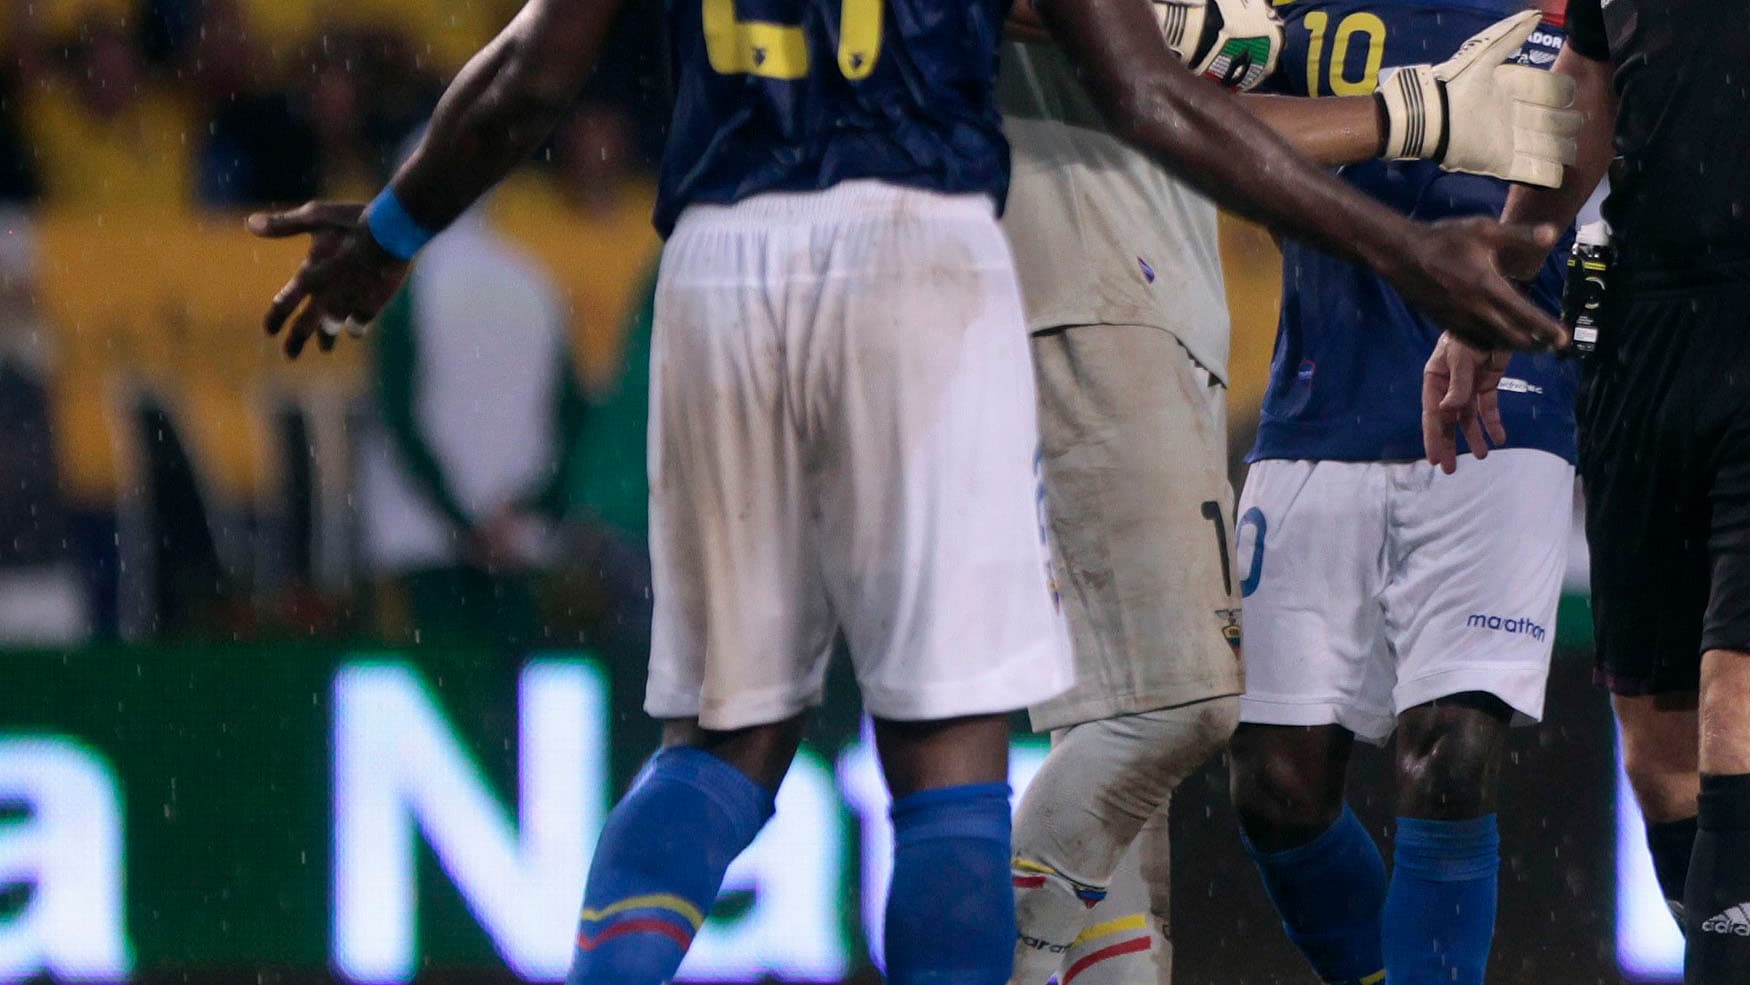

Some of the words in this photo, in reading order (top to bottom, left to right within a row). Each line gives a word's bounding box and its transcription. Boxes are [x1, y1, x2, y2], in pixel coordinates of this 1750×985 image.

[1304, 10, 1387, 98] 10
[1201, 500, 1232, 597] 1
[1467, 614, 1545, 643] maathon
